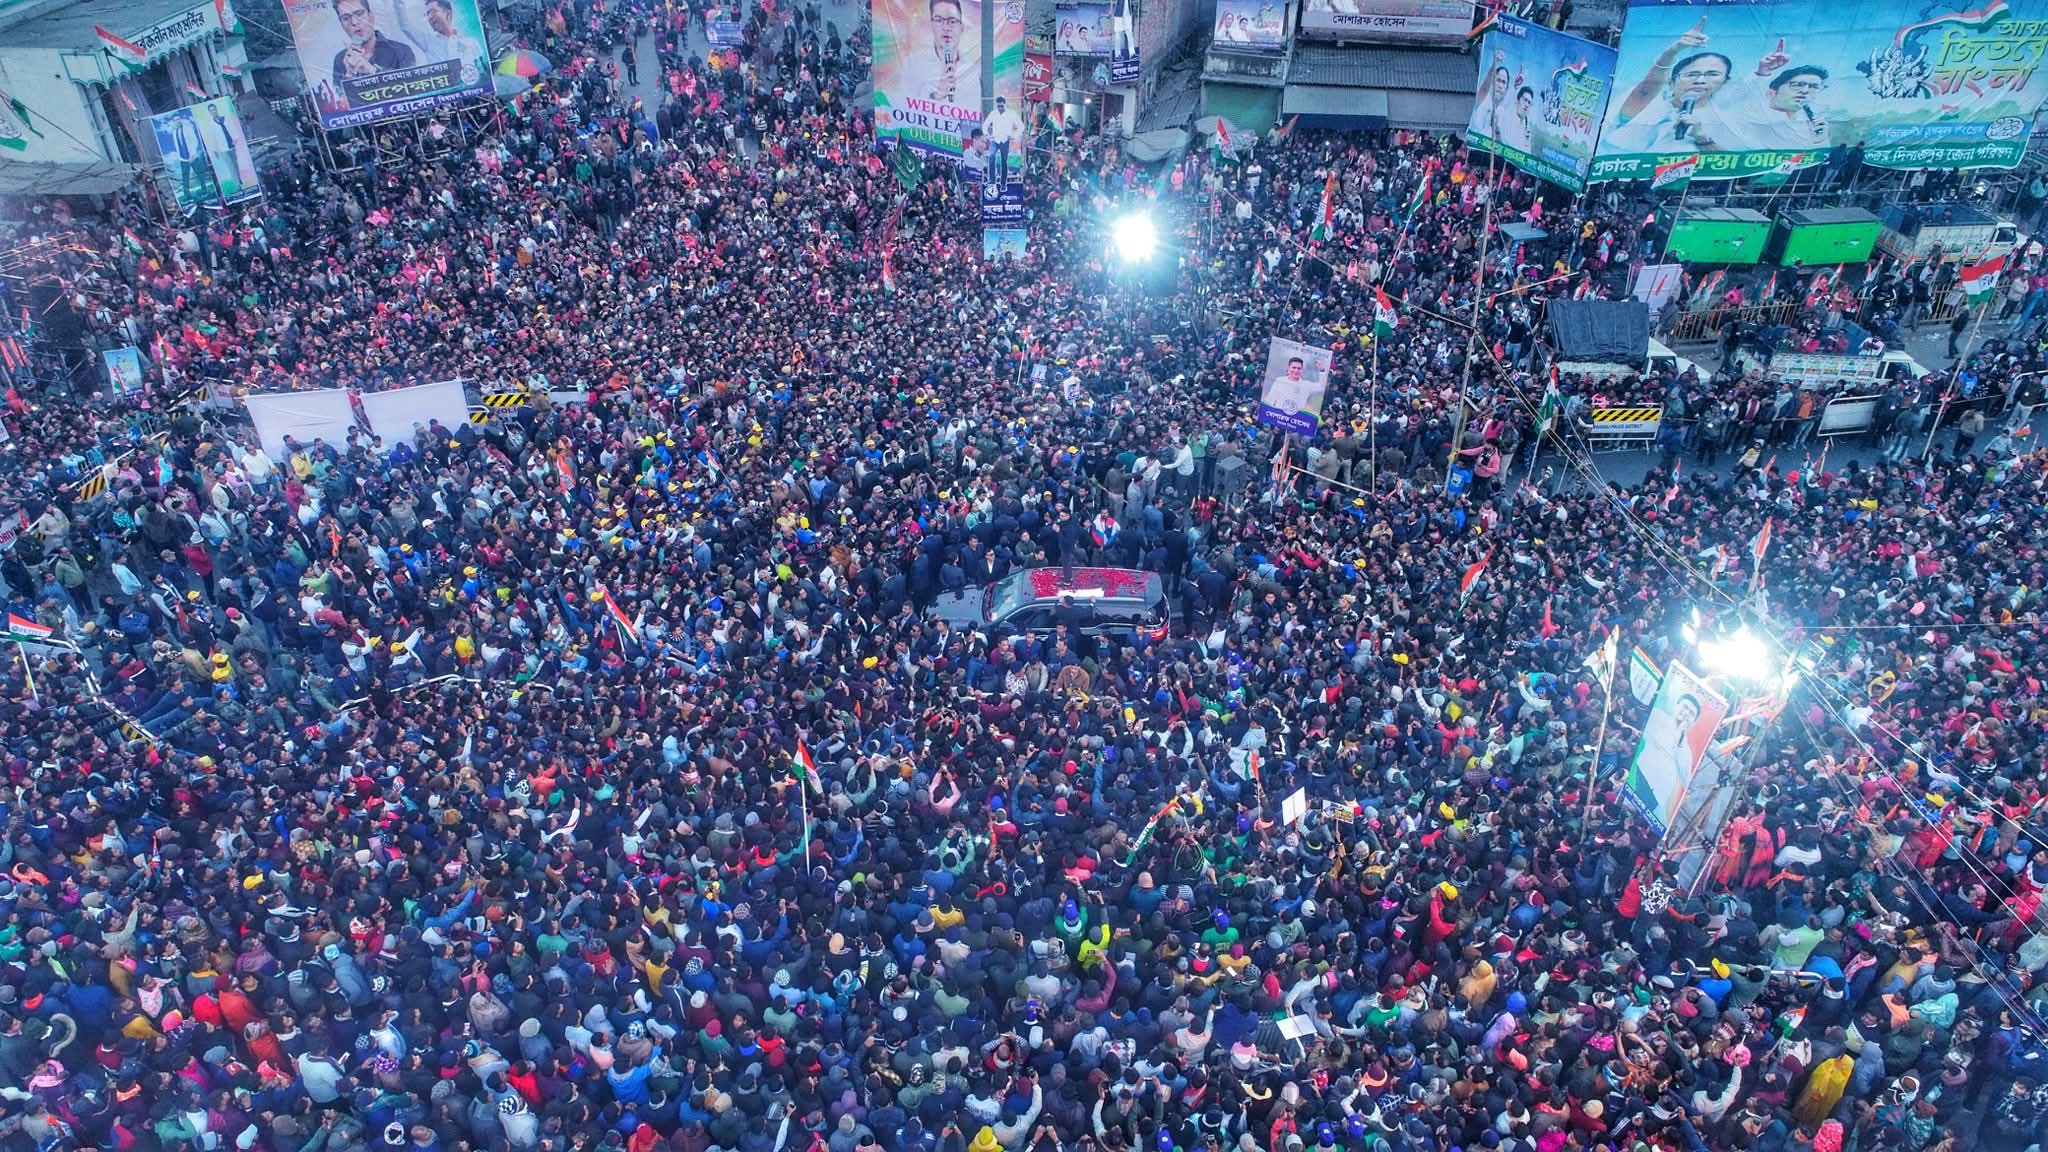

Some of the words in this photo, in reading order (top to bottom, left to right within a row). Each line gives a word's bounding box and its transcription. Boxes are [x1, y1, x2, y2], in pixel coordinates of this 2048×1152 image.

[1332, 15, 1371, 25] মোশারফ
[1373, 17, 1406, 28] হোসেন
[1997, 20, 2047, 37] আবা
[1937, 27, 2047, 66] জিতবে
[382, 70, 412, 83] তোমার
[1934, 65, 2039, 98] বাংলা
[359, 75, 449, 101] অপেক্ষায়
[328, 108, 384, 128] মোশারফ
[389, 98, 435, 115] হোসেন
[892, 109, 929, 127] OUR
[909, 128, 936, 143] OUR
